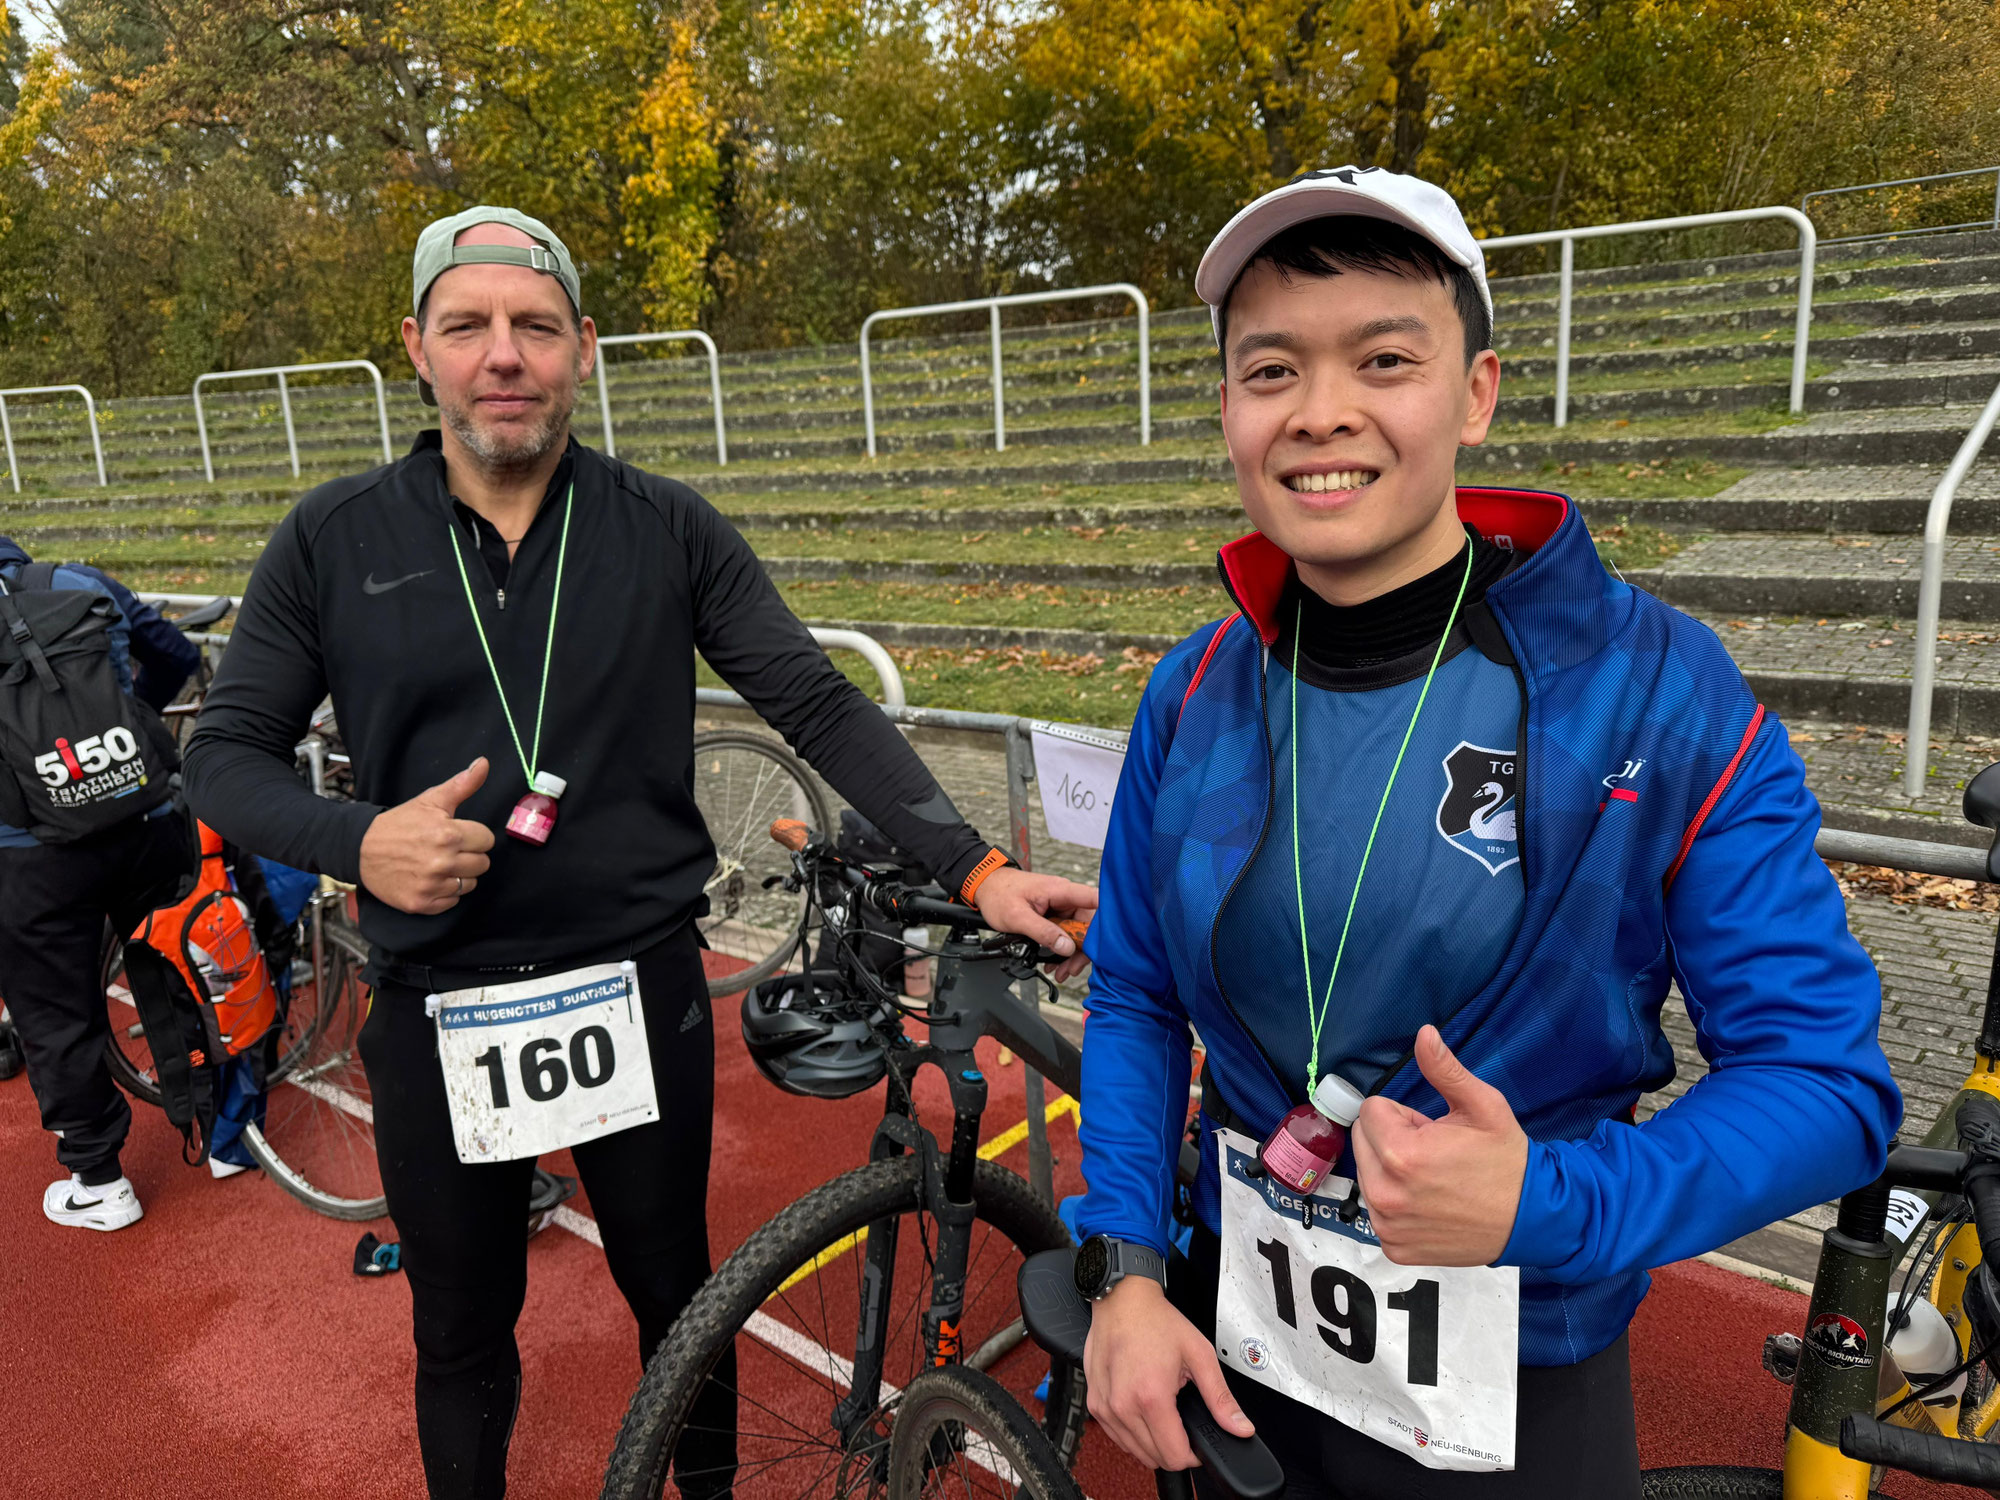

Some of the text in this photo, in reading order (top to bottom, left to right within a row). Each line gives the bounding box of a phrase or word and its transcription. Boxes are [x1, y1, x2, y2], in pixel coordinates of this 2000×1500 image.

[35, 726, 137, 788] 5i50
[46, 757, 144, 797] TRIATHLON
[1489, 760, 1514, 775] TG
[1057, 772, 1096, 811] 160
[1486, 845, 1505, 854] 1893
[473, 981, 627, 1021] HUGENOTTEN DUATHLON
[475, 1025, 616, 1109] 160
[1266, 1178, 1376, 1237] HGENOTEN
[1257, 1237, 1440, 1387] 191
[1827, 1349, 1872, 1364] MOUNTAIN
[1387, 1416, 1502, 1463] STADT NEU-ISENBURG
